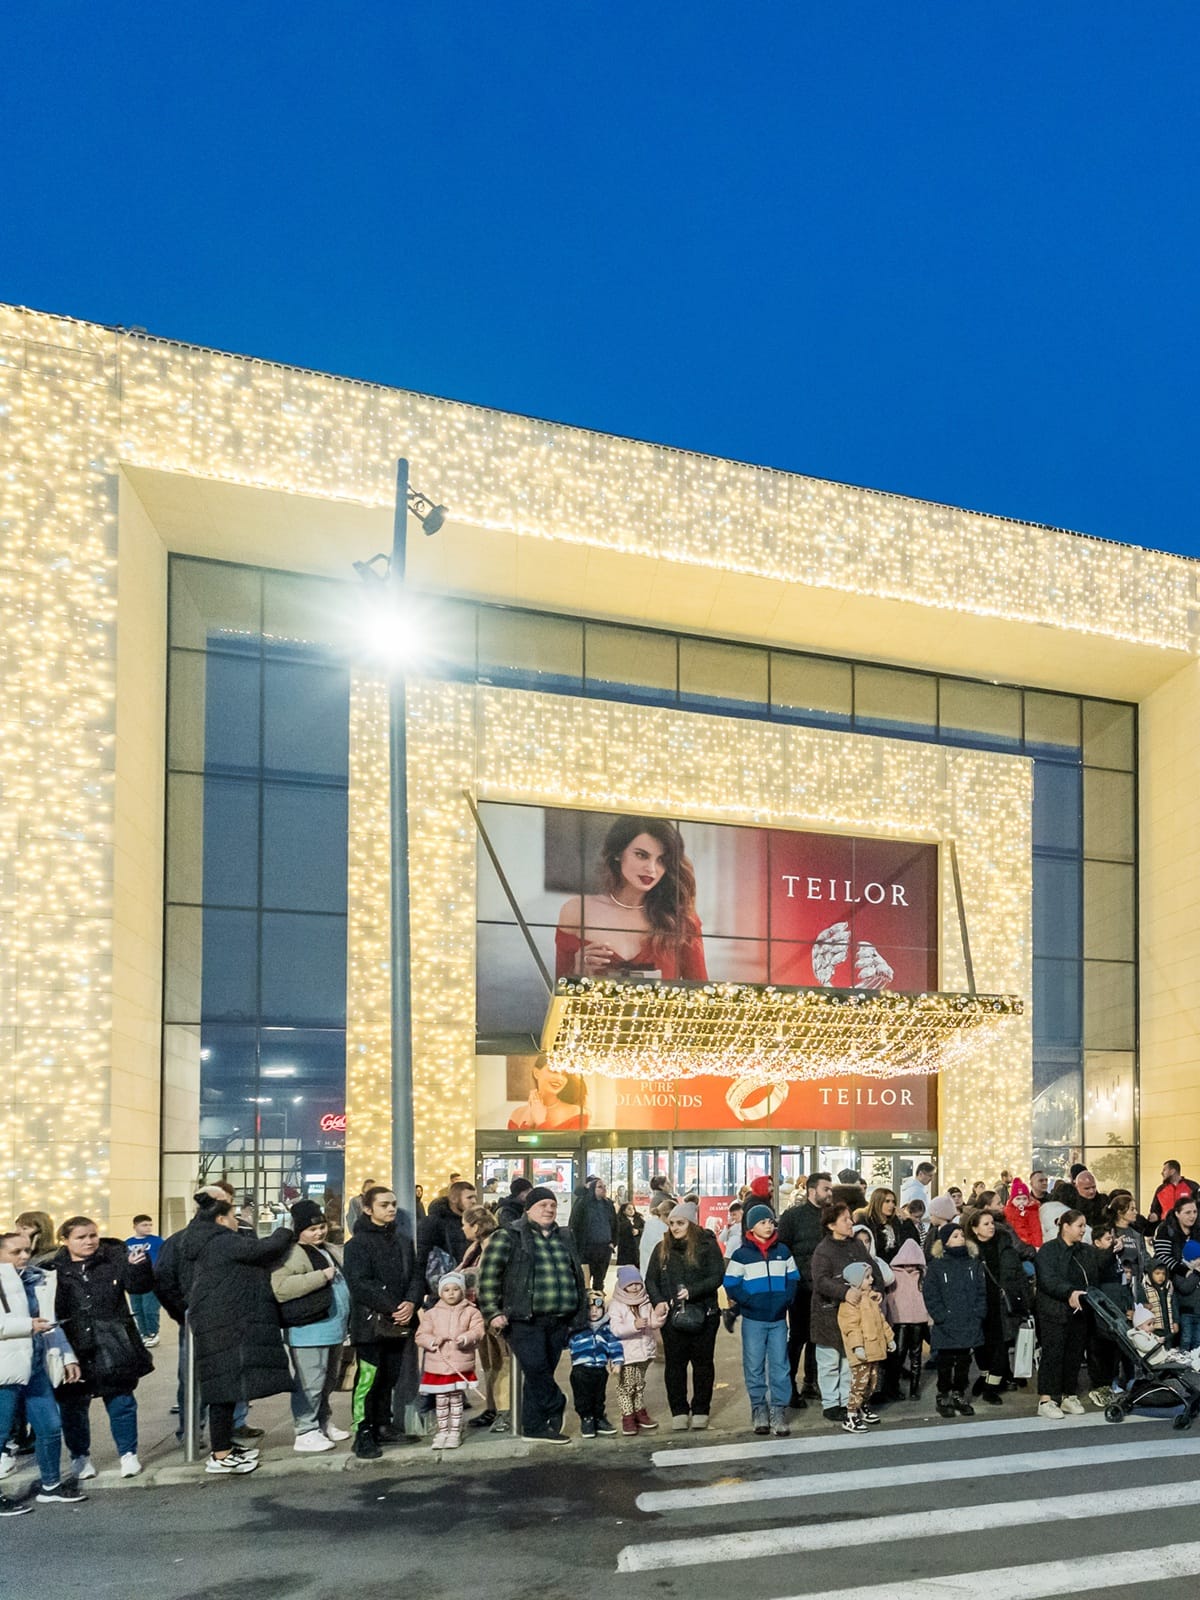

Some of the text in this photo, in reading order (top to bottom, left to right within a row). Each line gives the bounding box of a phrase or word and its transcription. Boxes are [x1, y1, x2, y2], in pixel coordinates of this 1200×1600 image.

[782, 875, 909, 906] TEILOR
[640, 1081, 675, 1093] PURE
[615, 1093, 703, 1108] DIAMONDS
[819, 1088, 915, 1105] TEILOR
